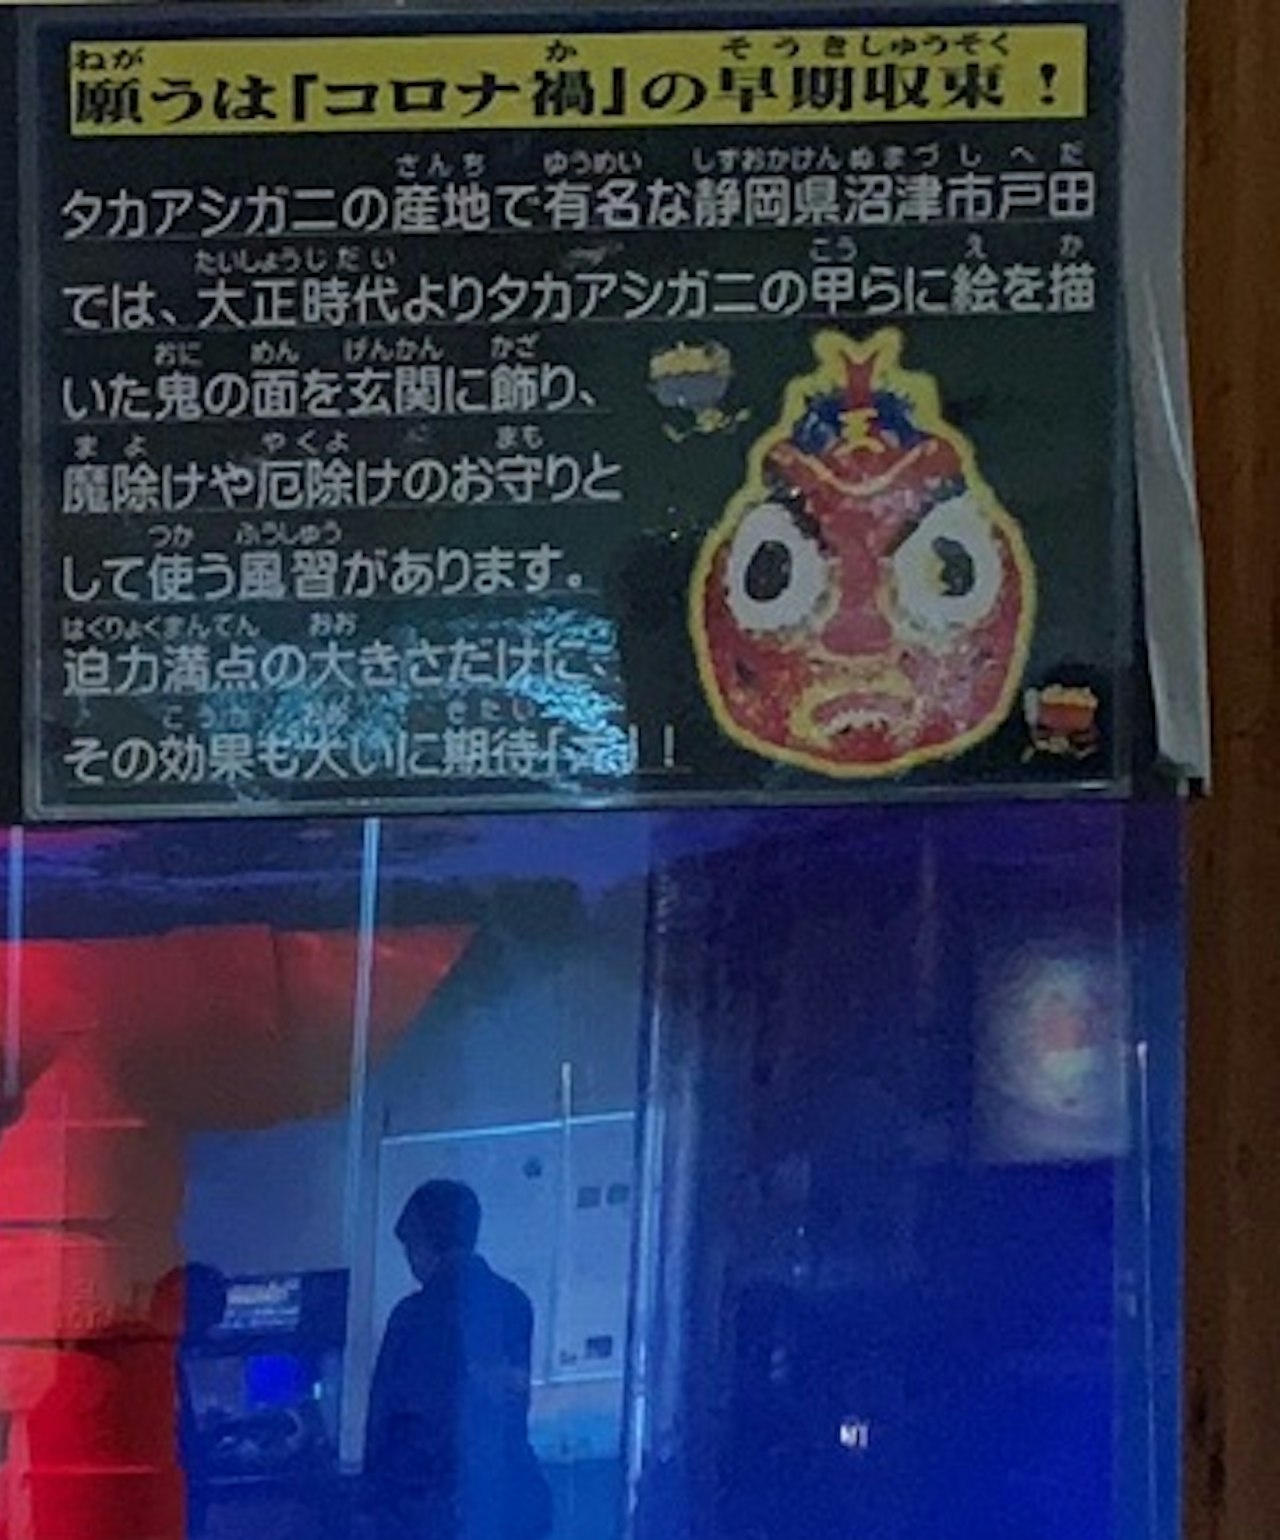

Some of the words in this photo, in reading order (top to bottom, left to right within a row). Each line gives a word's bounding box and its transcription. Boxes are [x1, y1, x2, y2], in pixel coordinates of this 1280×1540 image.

[75, 46, 144, 70] ねが
[546, 39, 578, 63] か
[73, 63, 1058, 126] 願うは「コロナ禍」の早期収束！
[395, 152, 486, 177] さんち
[543, 148, 643, 177] ゆうめい
[61, 169, 1096, 240] タカアシガニの産地で有名な静岡県沼津市戸田
[194, 247, 396, 274] たいしょうじだい
[809, 235, 858, 264] こう
[965, 233, 986, 259] え
[1059, 232, 1084, 259] か
[62, 262, 1096, 329] では、大正時代よりタカアシガニの甲らに絵を描
[154, 341, 203, 365] おに
[250, 342, 300, 364] めん
[344, 336, 444, 363] げんかん
[490, 333, 539, 359] かざ
[62, 362, 598, 420] いた鬼の面を玄関に飾り、
[495, 424, 544, 450] まも
[62, 451, 624, 514] 魔除けや厄除けのお守りと
[148, 525, 195, 547] つか
[62, 544, 584, 602] して使う風習があります。
[308, 612, 359, 637] おお
[62, 637, 608, 697] 迫力満点の大きさだけに、
[62, 722, 676, 785] その効果も大いに期待「」！
